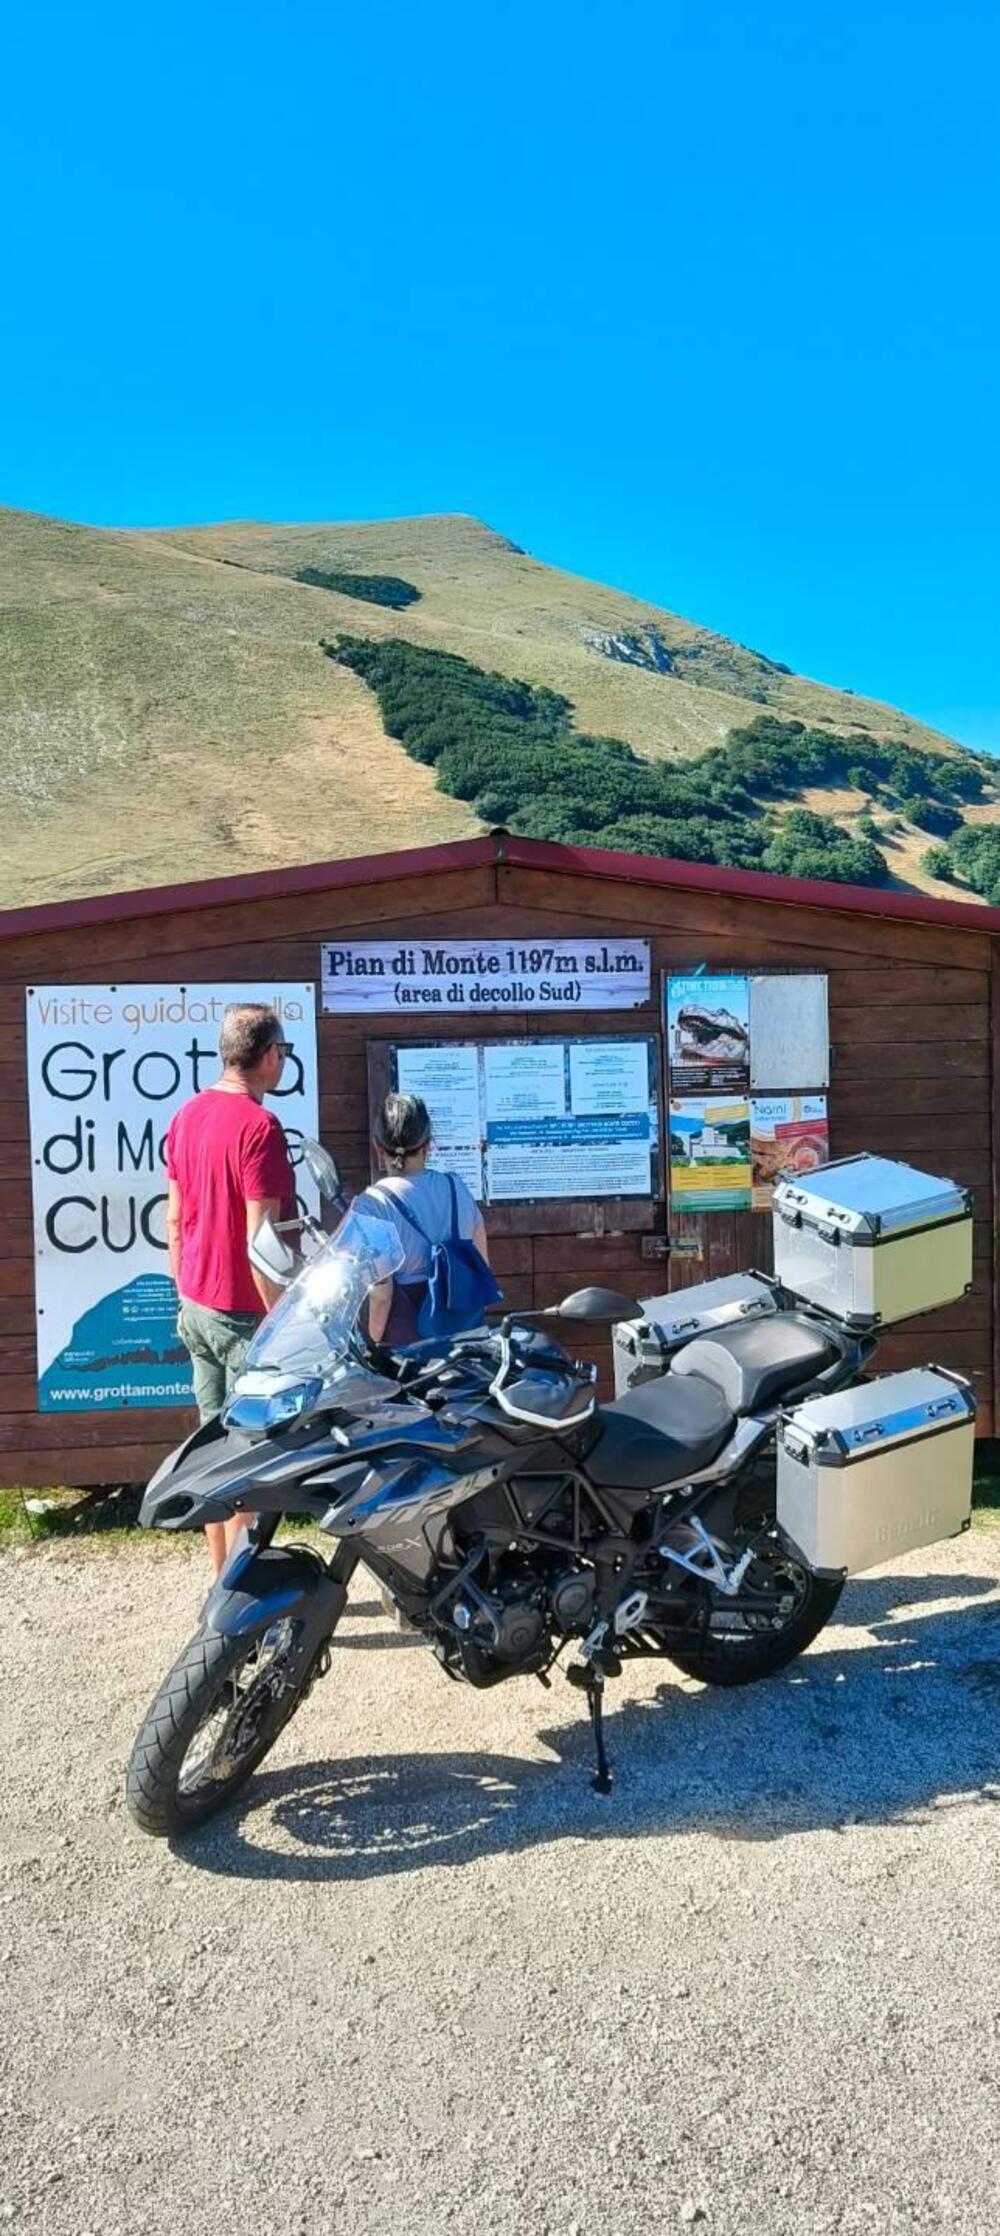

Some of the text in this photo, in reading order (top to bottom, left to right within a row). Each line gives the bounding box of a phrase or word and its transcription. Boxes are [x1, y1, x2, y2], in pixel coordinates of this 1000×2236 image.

[327, 947, 644, 976] Pian di Monte 1197m s.l.m.
[393, 980, 582, 1005] (area di decollo Sud)
[38, 998, 113, 1026] Visite
[122, 996, 226, 1035] guidat
[41, 1037, 306, 1101] Grota
[43, 1114, 95, 1175] di
[50, 1381, 195, 1401] www.grottamonte
